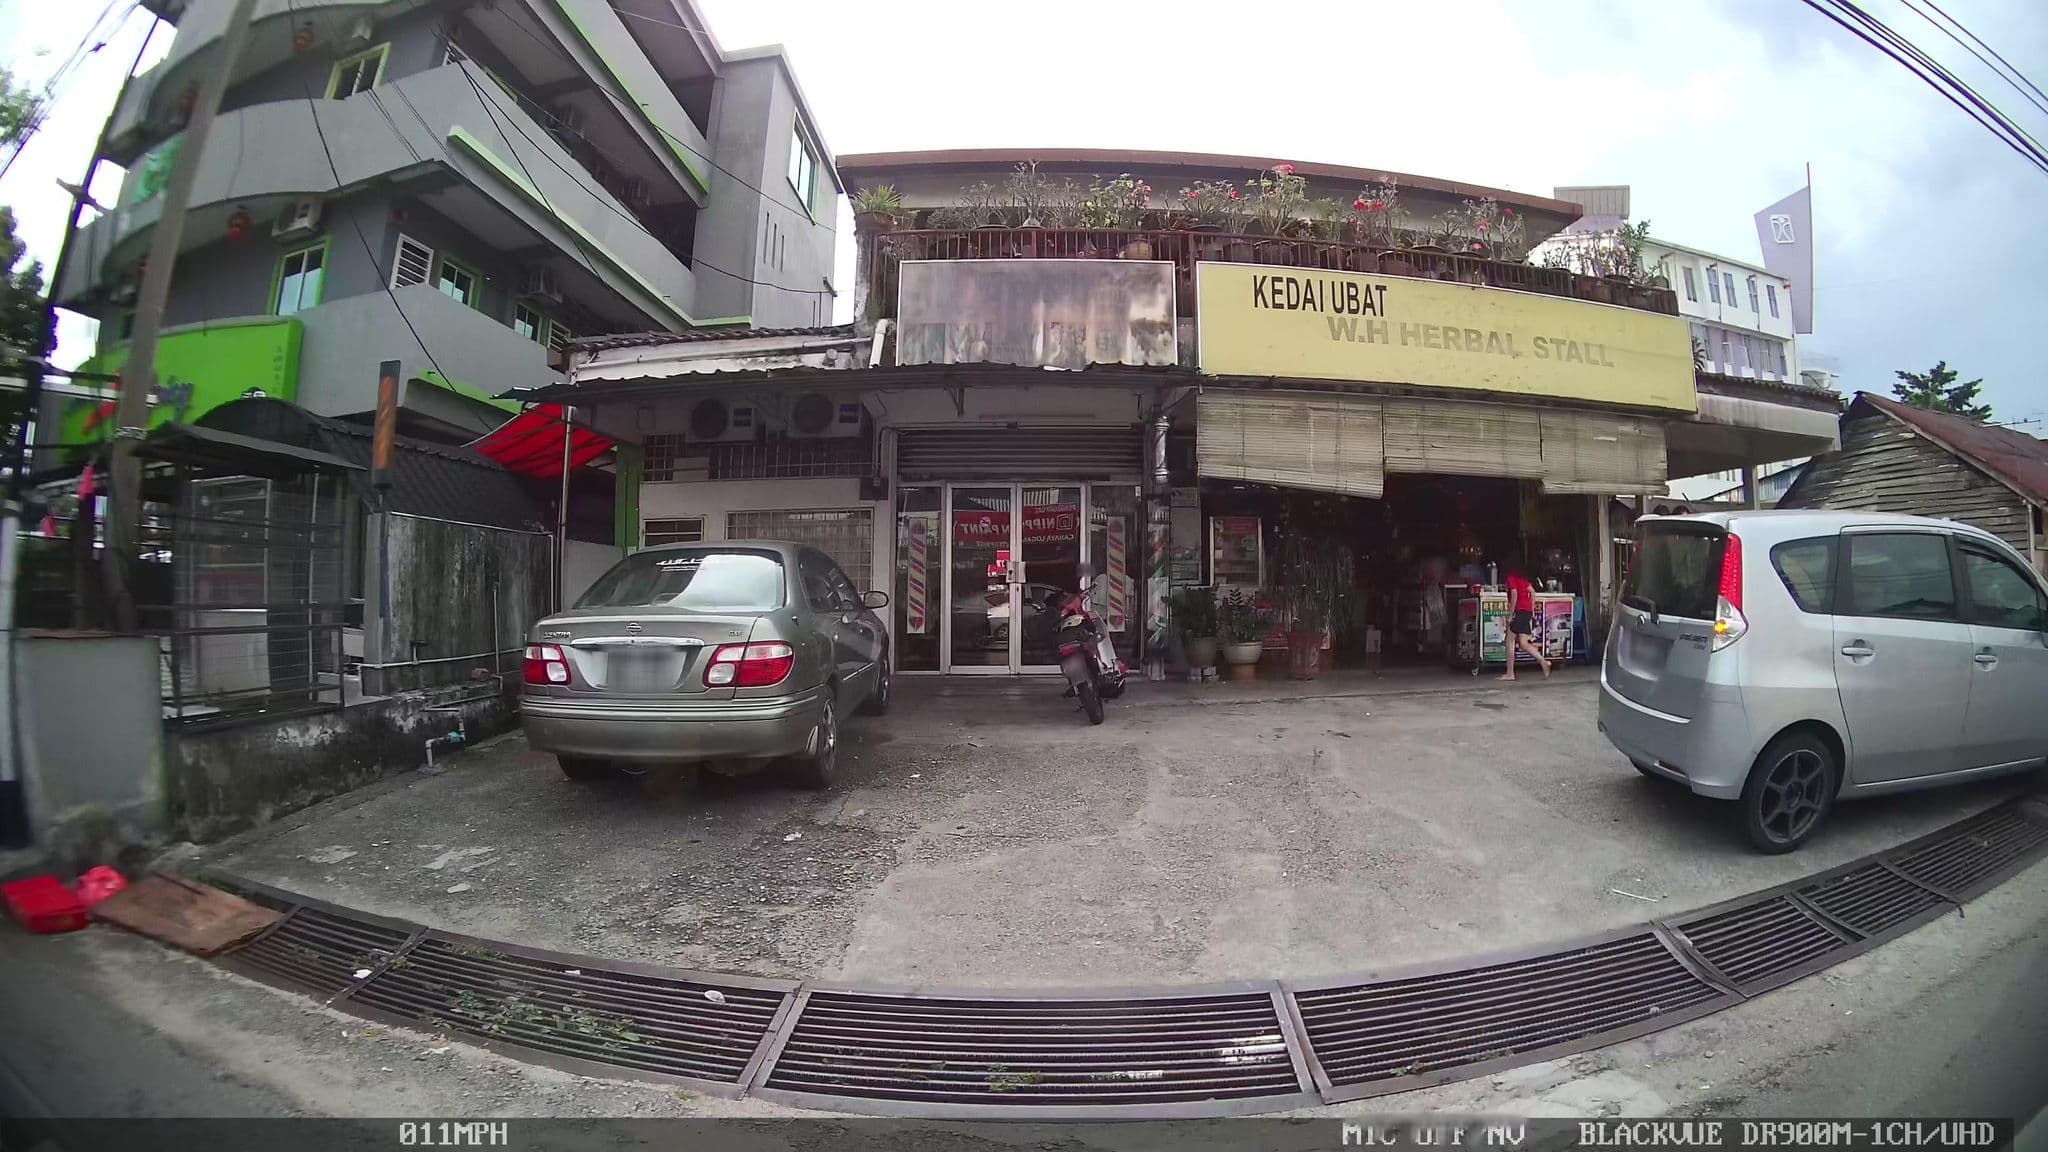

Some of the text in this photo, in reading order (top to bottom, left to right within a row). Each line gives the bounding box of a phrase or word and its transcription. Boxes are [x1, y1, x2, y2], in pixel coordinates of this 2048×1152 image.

[1253, 275, 1387, 317] KEDAI UBAT
[1327, 316, 1614, 367] W.H HERBAL STALL
